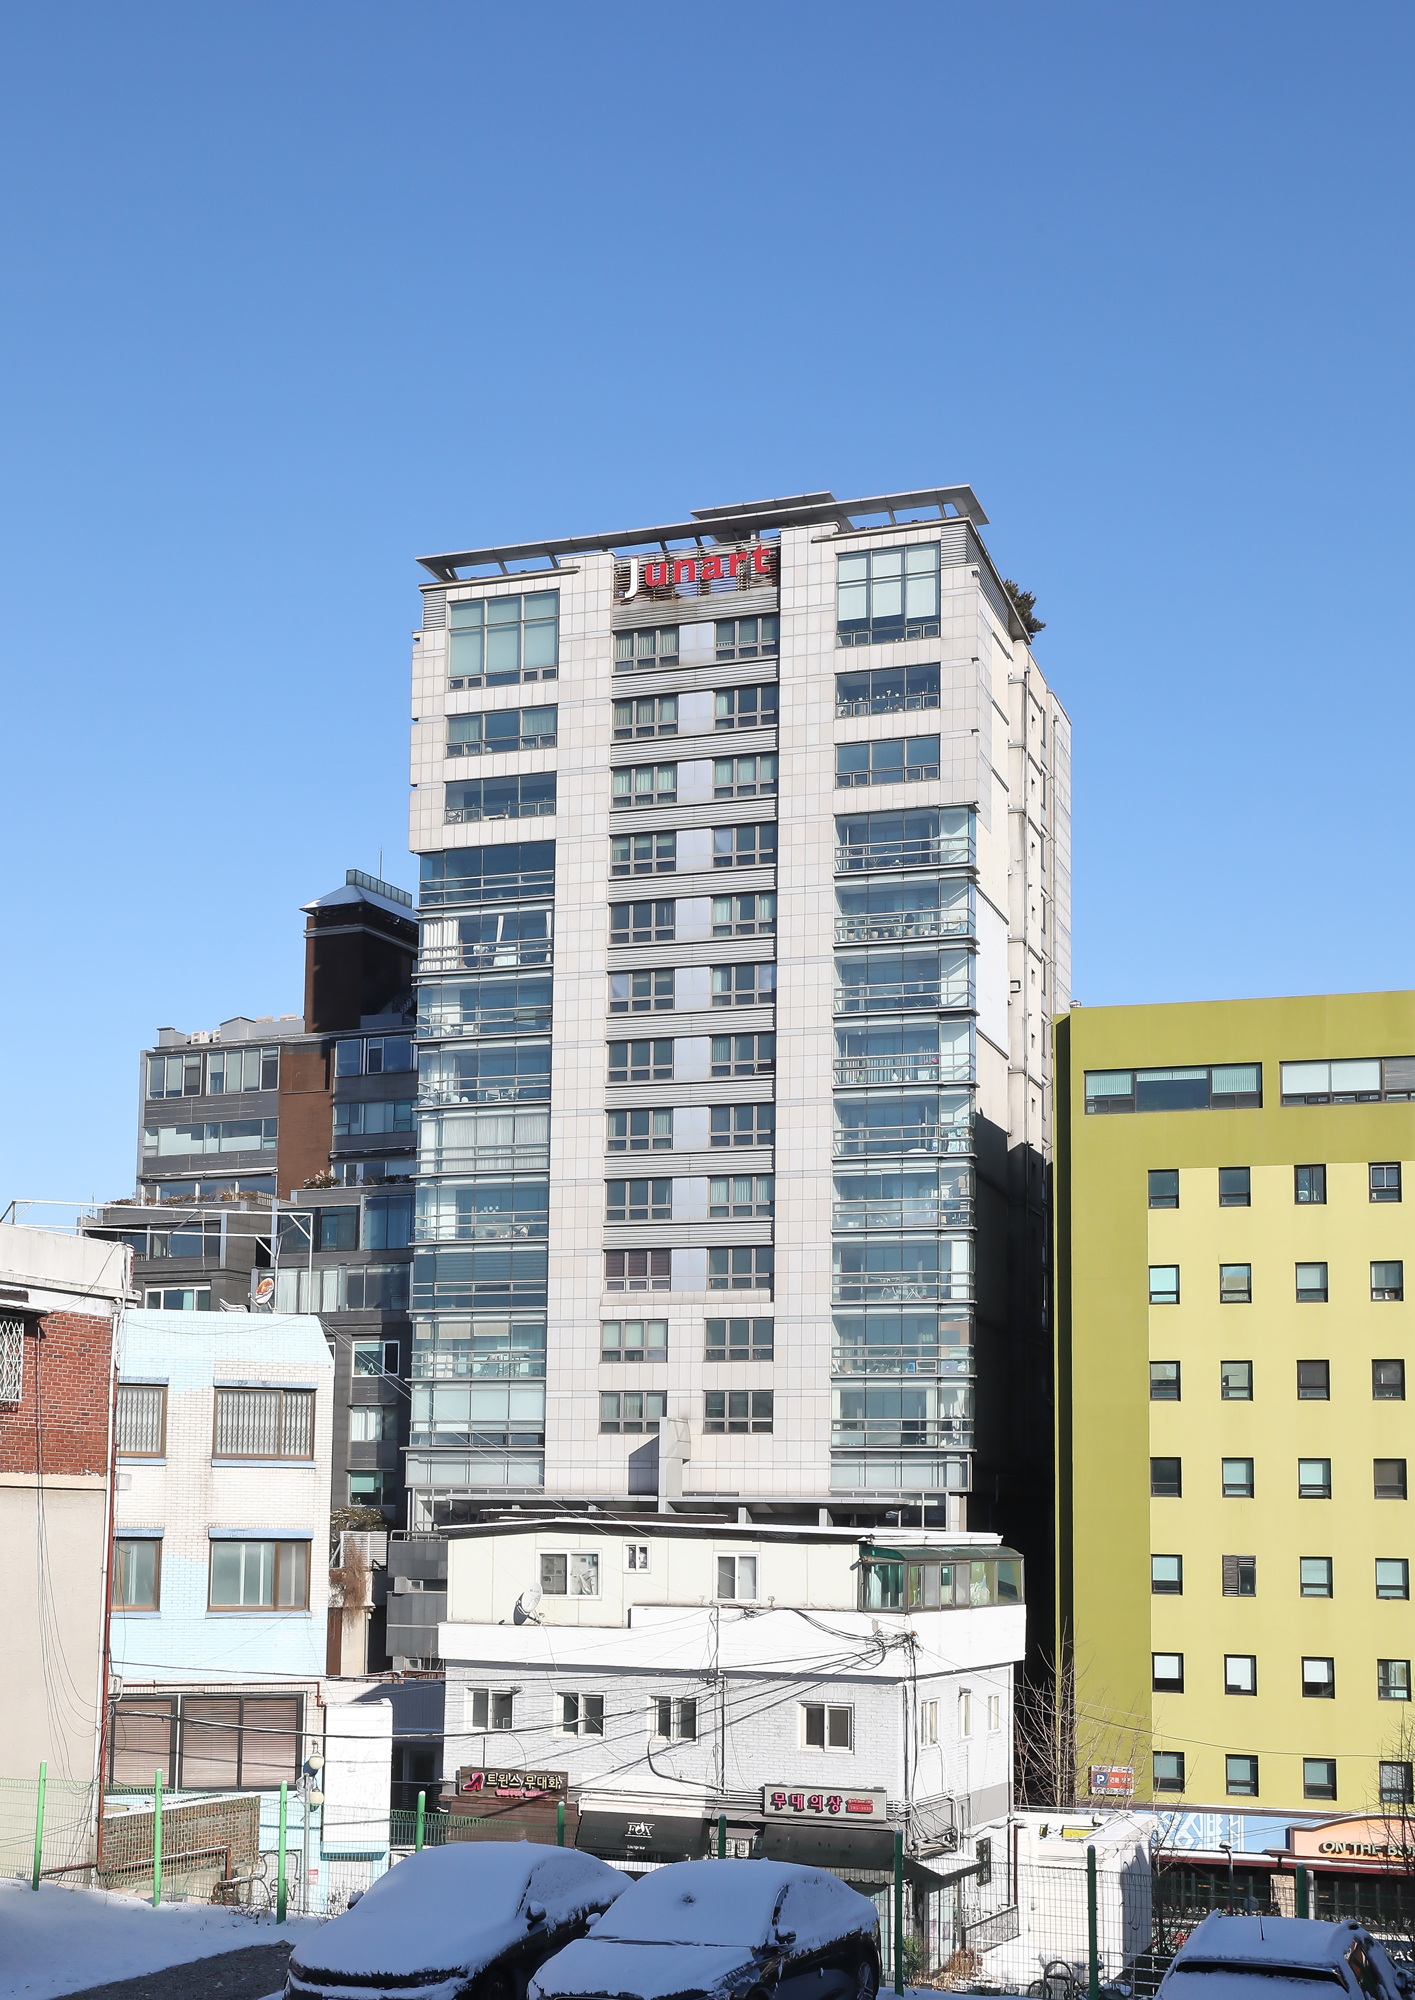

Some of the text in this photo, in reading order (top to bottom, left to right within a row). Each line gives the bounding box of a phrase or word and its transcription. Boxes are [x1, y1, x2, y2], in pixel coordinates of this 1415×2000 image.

[624, 544, 771, 598] Junart
[486, 1773, 560, 1789] 트윈스 무대화
[1322, 1841, 1346, 1852] ON
[1350, 1842, 1382, 1855] THE
